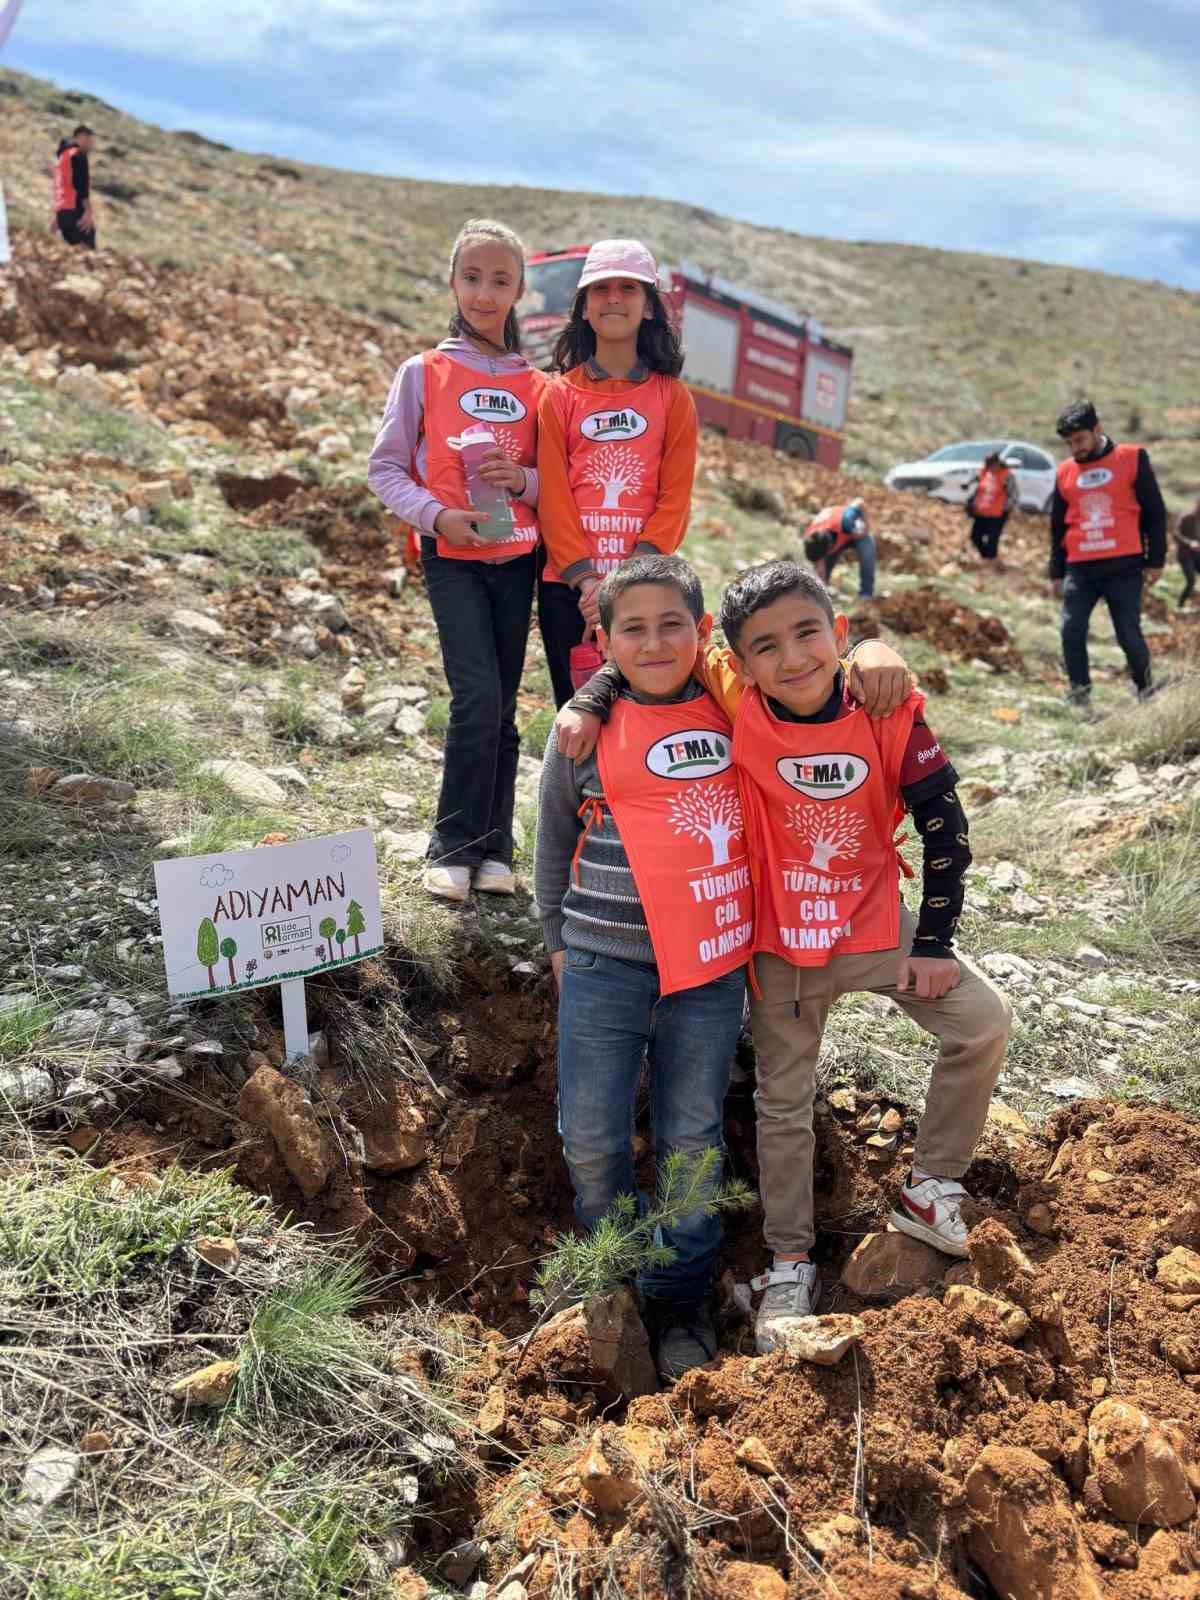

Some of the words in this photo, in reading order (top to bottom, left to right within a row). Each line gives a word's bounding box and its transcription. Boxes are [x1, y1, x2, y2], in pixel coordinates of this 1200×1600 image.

[474, 393, 509, 410] TEMA
[594, 413, 629, 428] TEMA
[580, 511, 643, 533] TÜRKİYE
[598, 533, 627, 557] ÇÖL
[663, 738, 714, 764] TEMA
[793, 761, 842, 784] TEMA
[689, 865, 751, 904] TÜRKİYE
[781, 865, 863, 894] TÜRKİYE
[213, 872, 346, 923] ADIYAMAN
[800, 896, 839, 925] ÇÖL
[715, 897, 741, 931] ÇÖL
[699, 920, 752, 963] OLMASIN
